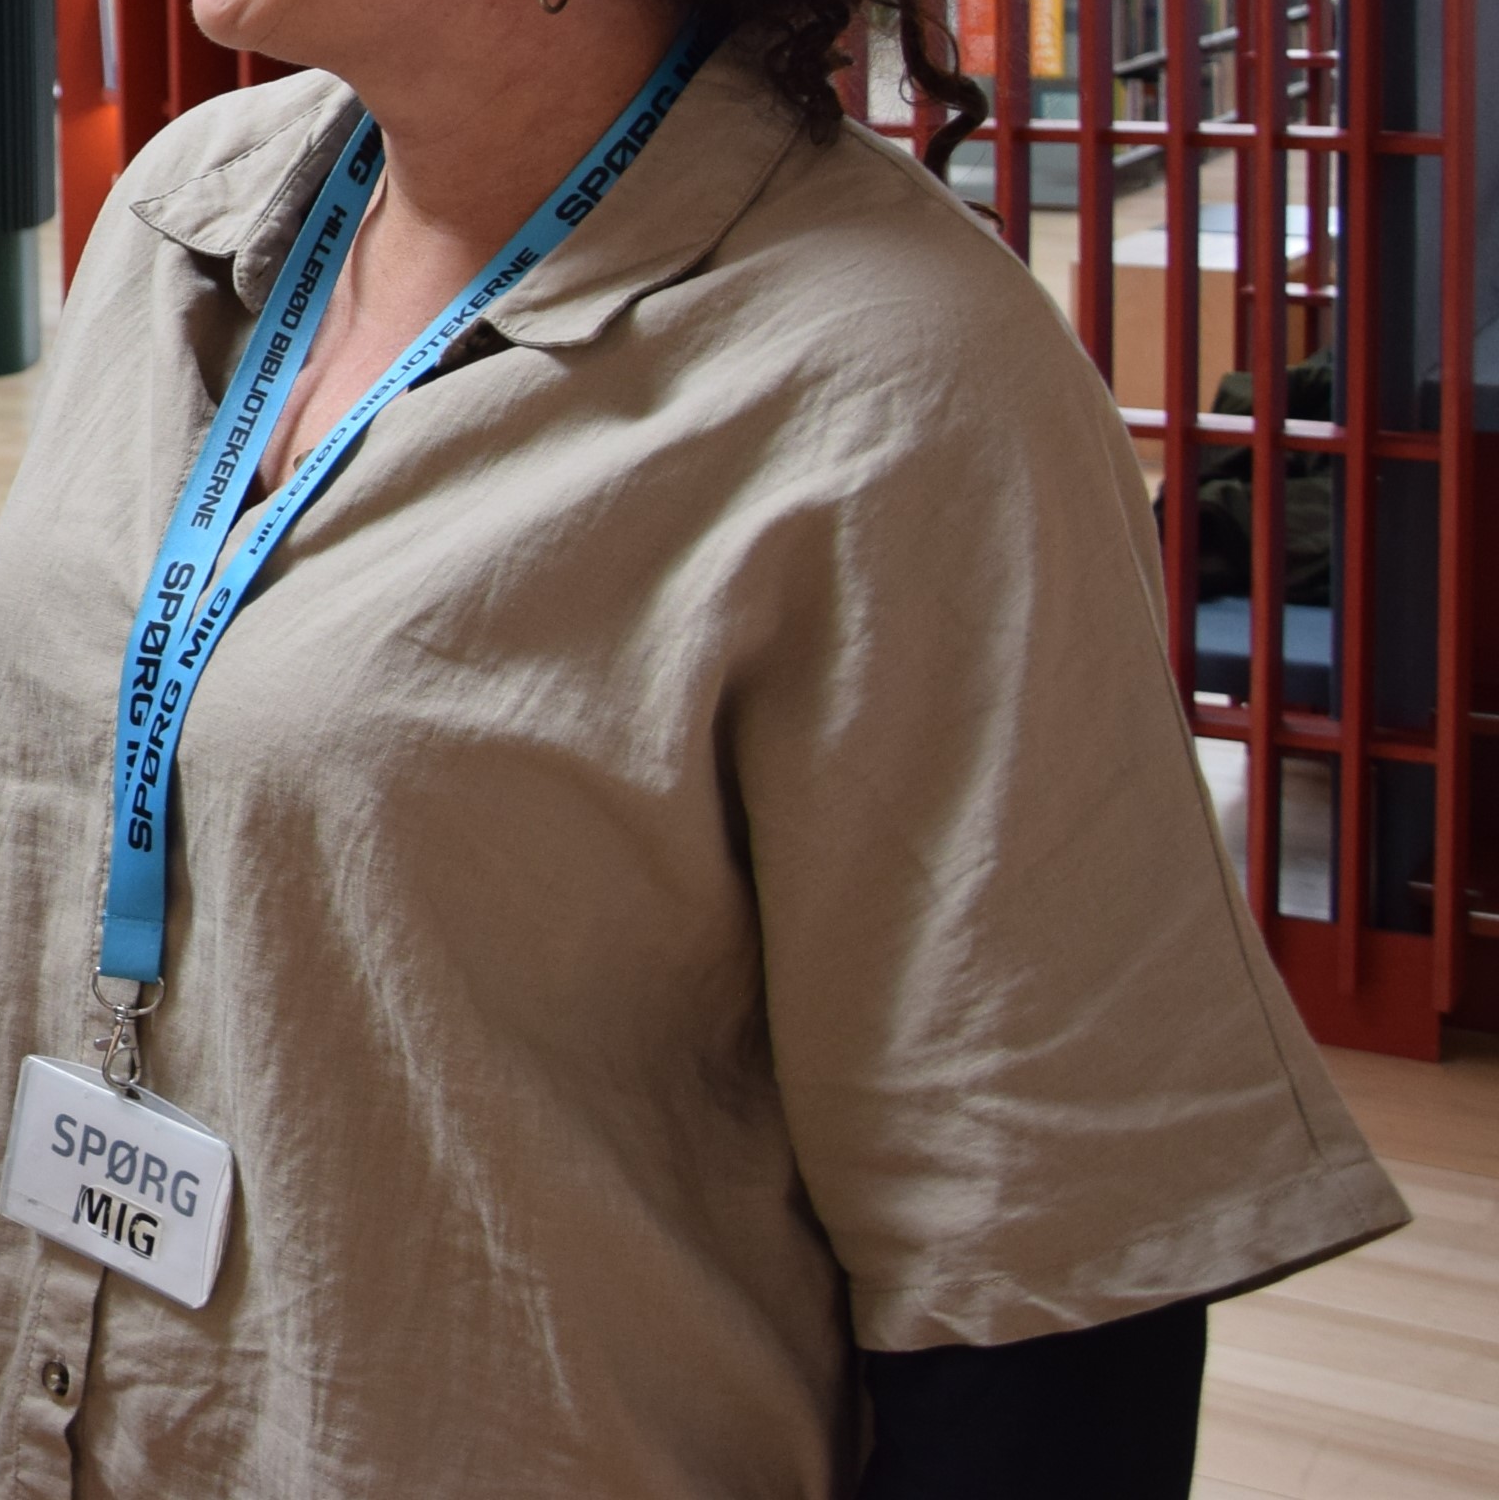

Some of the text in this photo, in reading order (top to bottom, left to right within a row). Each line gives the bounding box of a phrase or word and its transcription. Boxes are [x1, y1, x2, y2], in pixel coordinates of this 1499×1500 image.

[190, 204, 348, 531] HILLERØD BIBLIOTEKERNE
[248, 247, 541, 556] HILLERØD BIBLIOTEKERNE
[128, 560, 196, 727] SPØRG
[128, 586, 231, 853] SPØRG MIG
[51, 1113, 200, 1218] SPØRG
[72, 1184, 160, 1260] MIG
